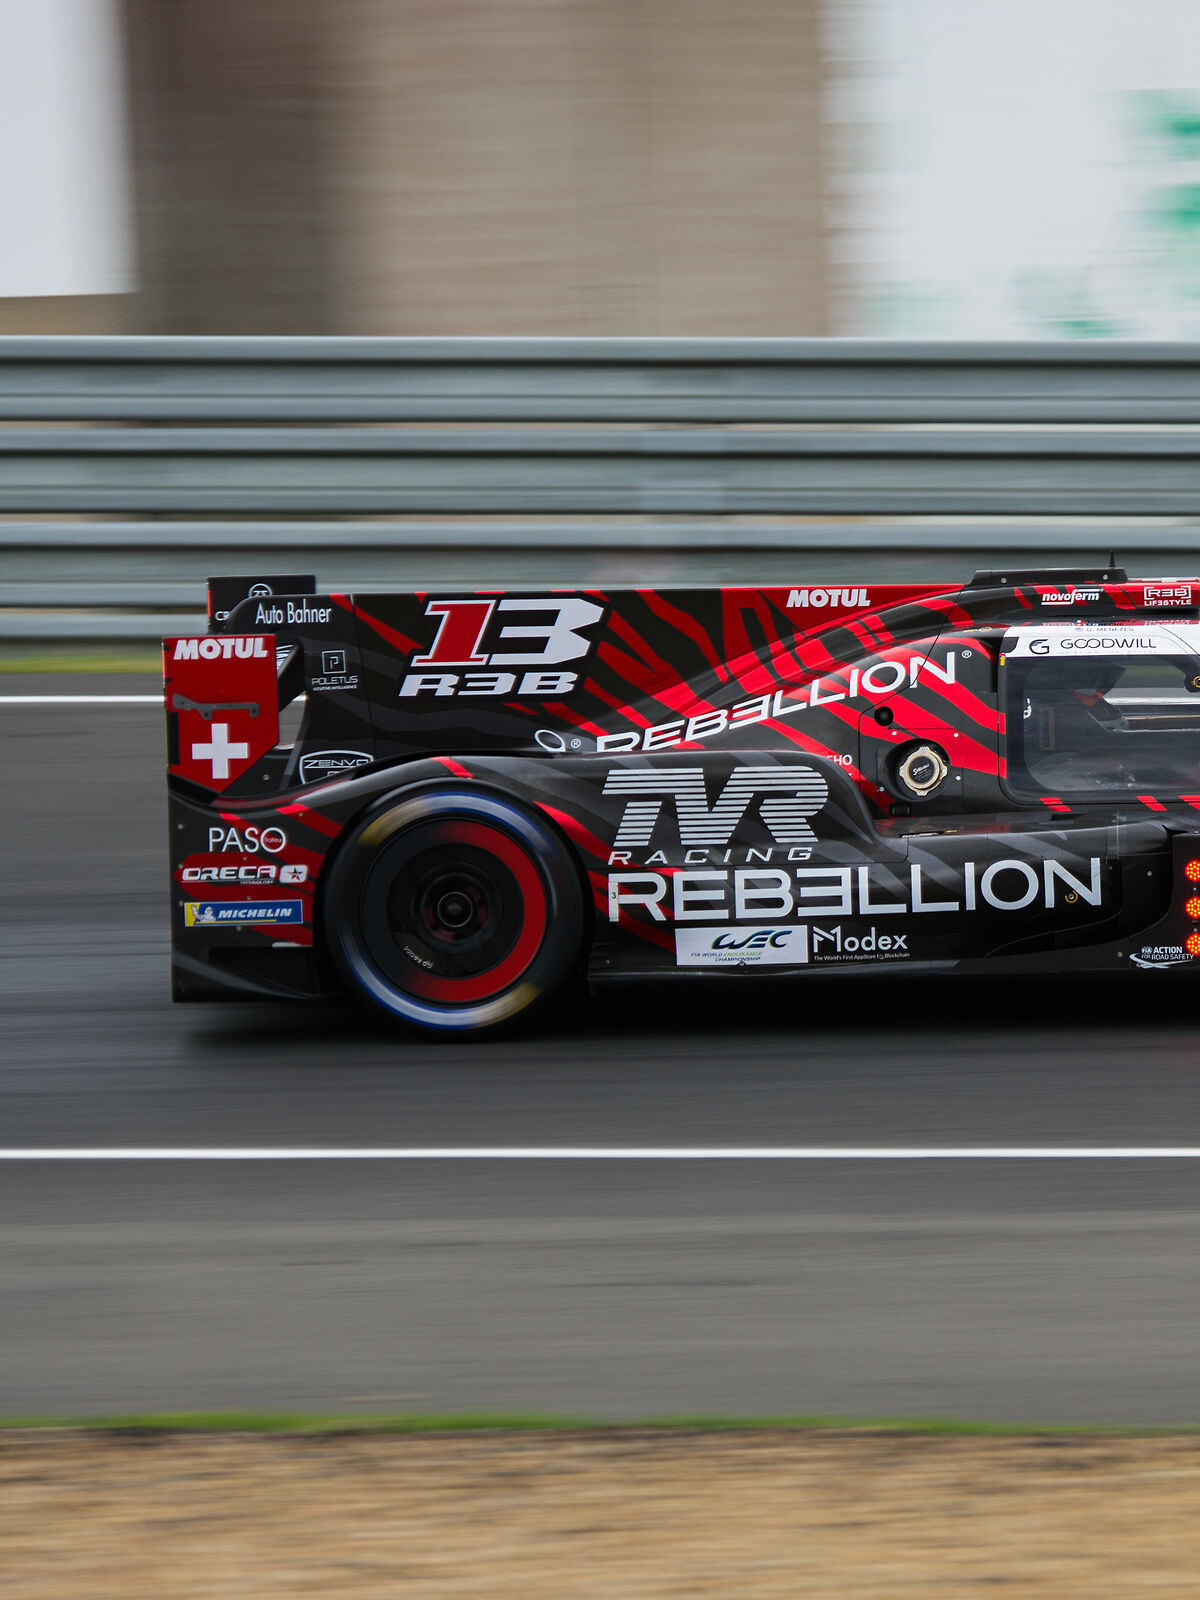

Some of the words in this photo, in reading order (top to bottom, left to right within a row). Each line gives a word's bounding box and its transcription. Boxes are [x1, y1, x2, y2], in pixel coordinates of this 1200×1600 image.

[786, 589, 871, 608] MOTUL
[1042, 588, 1102, 604] novoferm
[256, 602, 284, 625] Auto
[287, 598, 332, 624] Bahner
[411, 598, 604, 667] 13
[173, 637, 268, 660] MOTUL
[1060, 637, 1157, 649] GOODWILL
[312, 675, 359, 687] POLETUS
[602, 766, 829, 847] TVR
[208, 826, 287, 853] PASO
[608, 846, 813, 866] RACING
[182, 865, 277, 881] ORECA
[218, 907, 293, 920] MICHELIN
[710, 929, 793, 950] WEC
[812, 925, 908, 953] Modex
[1151, 953, 1170, 961] ROAD
[1153, 946, 1183, 954] ACTION
